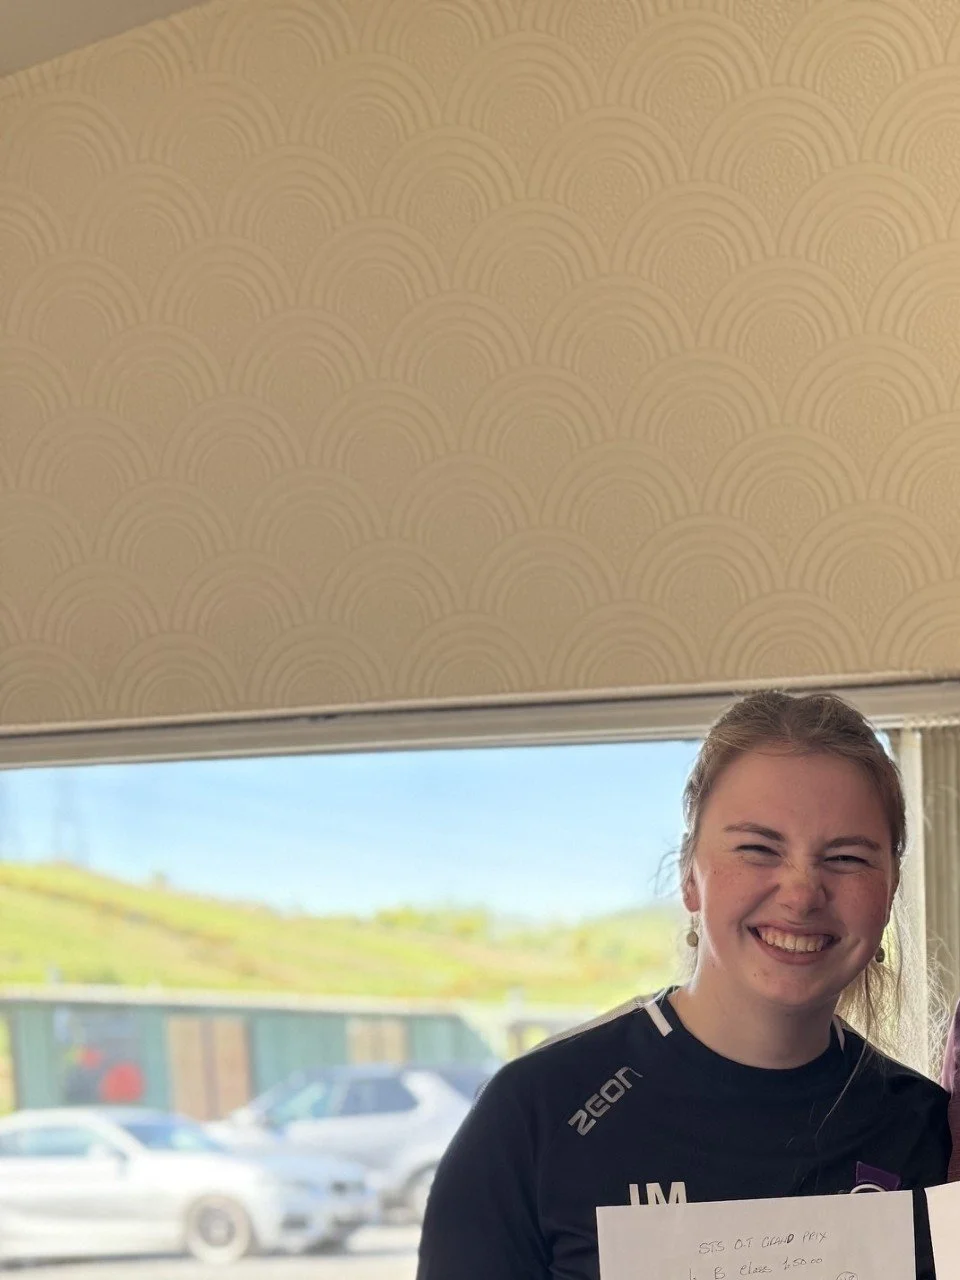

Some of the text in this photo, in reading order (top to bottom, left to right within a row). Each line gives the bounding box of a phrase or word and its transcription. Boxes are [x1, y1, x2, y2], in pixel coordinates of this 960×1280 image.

[698, 1240, 725, 1255] STS
[761, 1233, 795, 1249] GRAND
[802, 1231, 828, 1243] PRIX
[714, 1266, 726, 1280] B
